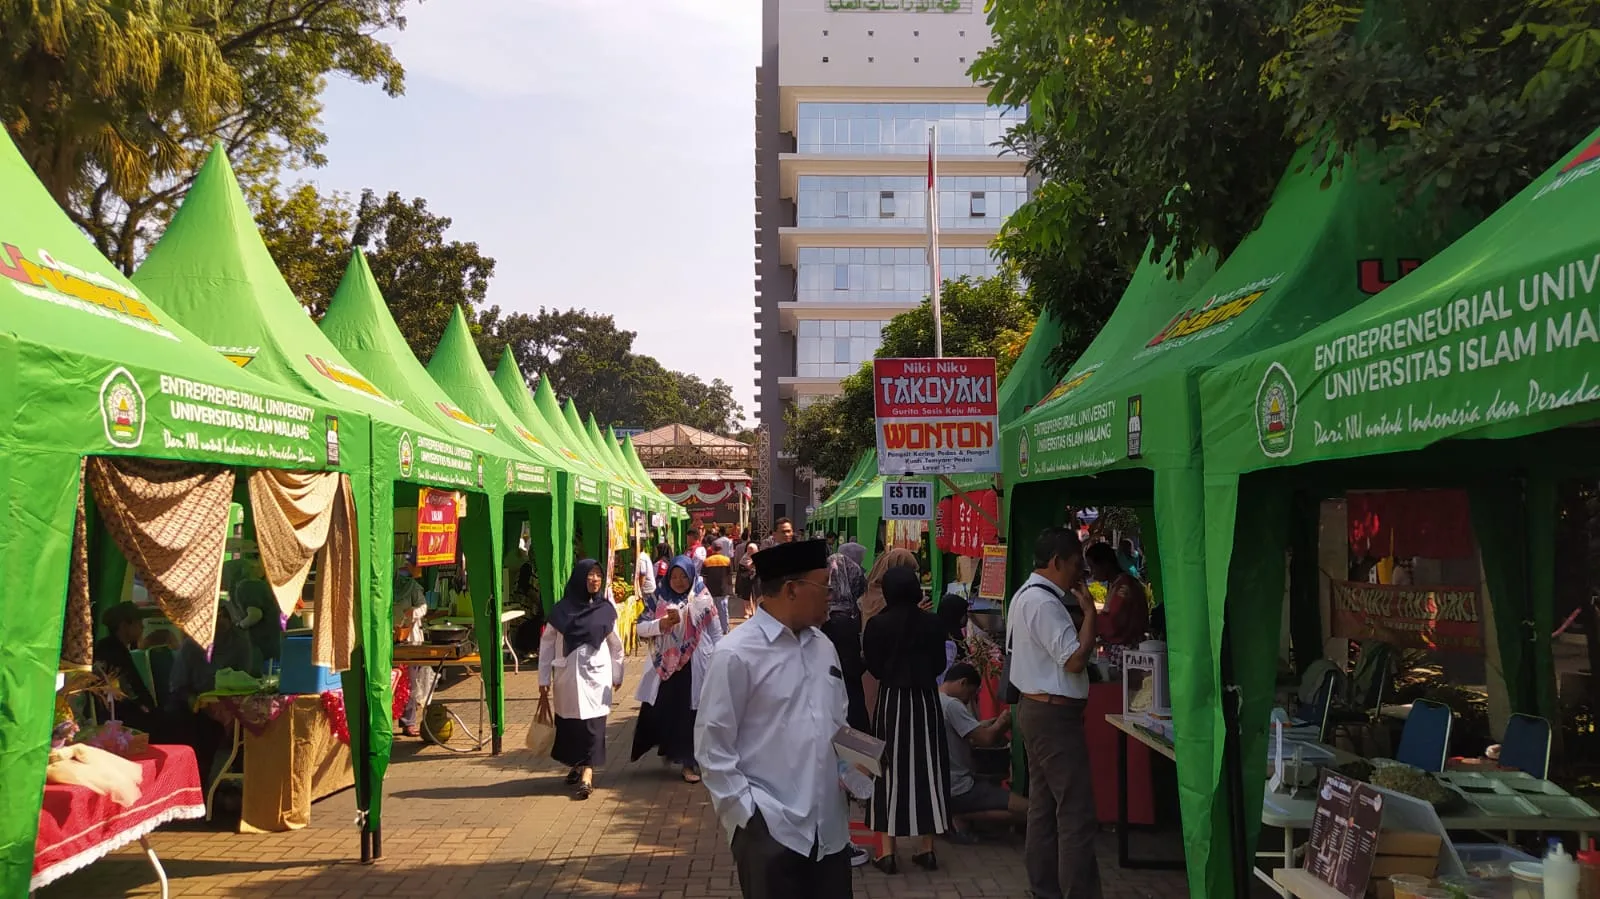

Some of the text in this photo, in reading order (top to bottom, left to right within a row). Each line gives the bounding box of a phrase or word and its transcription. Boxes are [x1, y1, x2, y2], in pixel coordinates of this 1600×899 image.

[1314, 285, 1513, 372] ENTREPRENEURIAL
[904, 362, 968, 373] Niki Niku
[1324, 345, 1450, 401] UNIVERSITAS
[1459, 321, 1537, 373] ISLAM
[160, 374, 315, 423] ENTREPRENEURIAL UNIVERSITY
[880, 375, 992, 405] TAKOYAKI
[170, 400, 310, 440] UNIVERSITAS ISLAM MALANG
[892, 407, 919, 416] Gurita
[1078, 399, 1117, 426] UNIVERSITY
[1314, 420, 1343, 447] Dari
[1365, 408, 1403, 439] untuk
[1408, 401, 1481, 433] Indonesia
[1486, 390, 1520, 422] dan
[883, 421, 993, 449] WONTON
[1066, 428, 1085, 449] ISLAM
[1084, 423, 1112, 444] MALANG
[889, 486, 927, 499] ES TEH
[891, 503, 926, 516] 5.000
